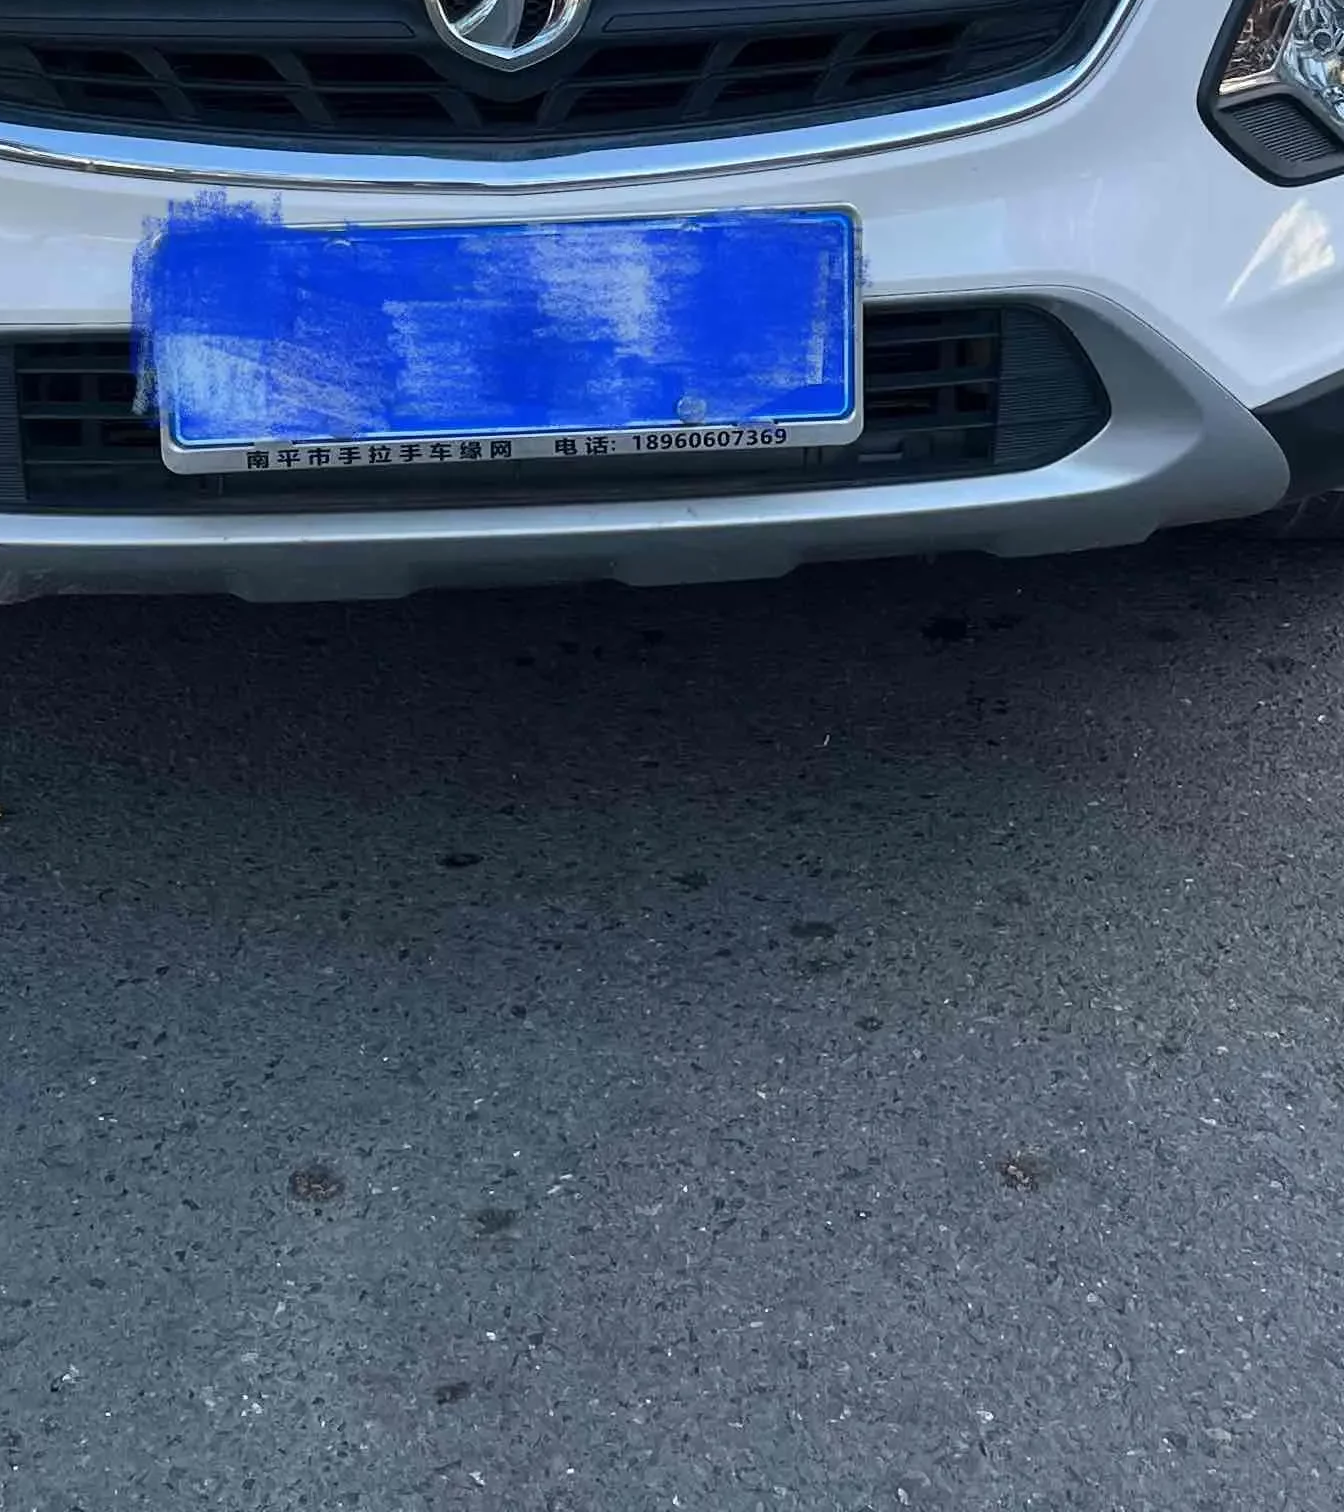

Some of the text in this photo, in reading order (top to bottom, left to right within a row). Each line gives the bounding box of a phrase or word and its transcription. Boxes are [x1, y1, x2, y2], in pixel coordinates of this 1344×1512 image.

[246, 439, 513, 470] 南平市手拉手车缘网
[631, 428, 788, 451] 18960607369
